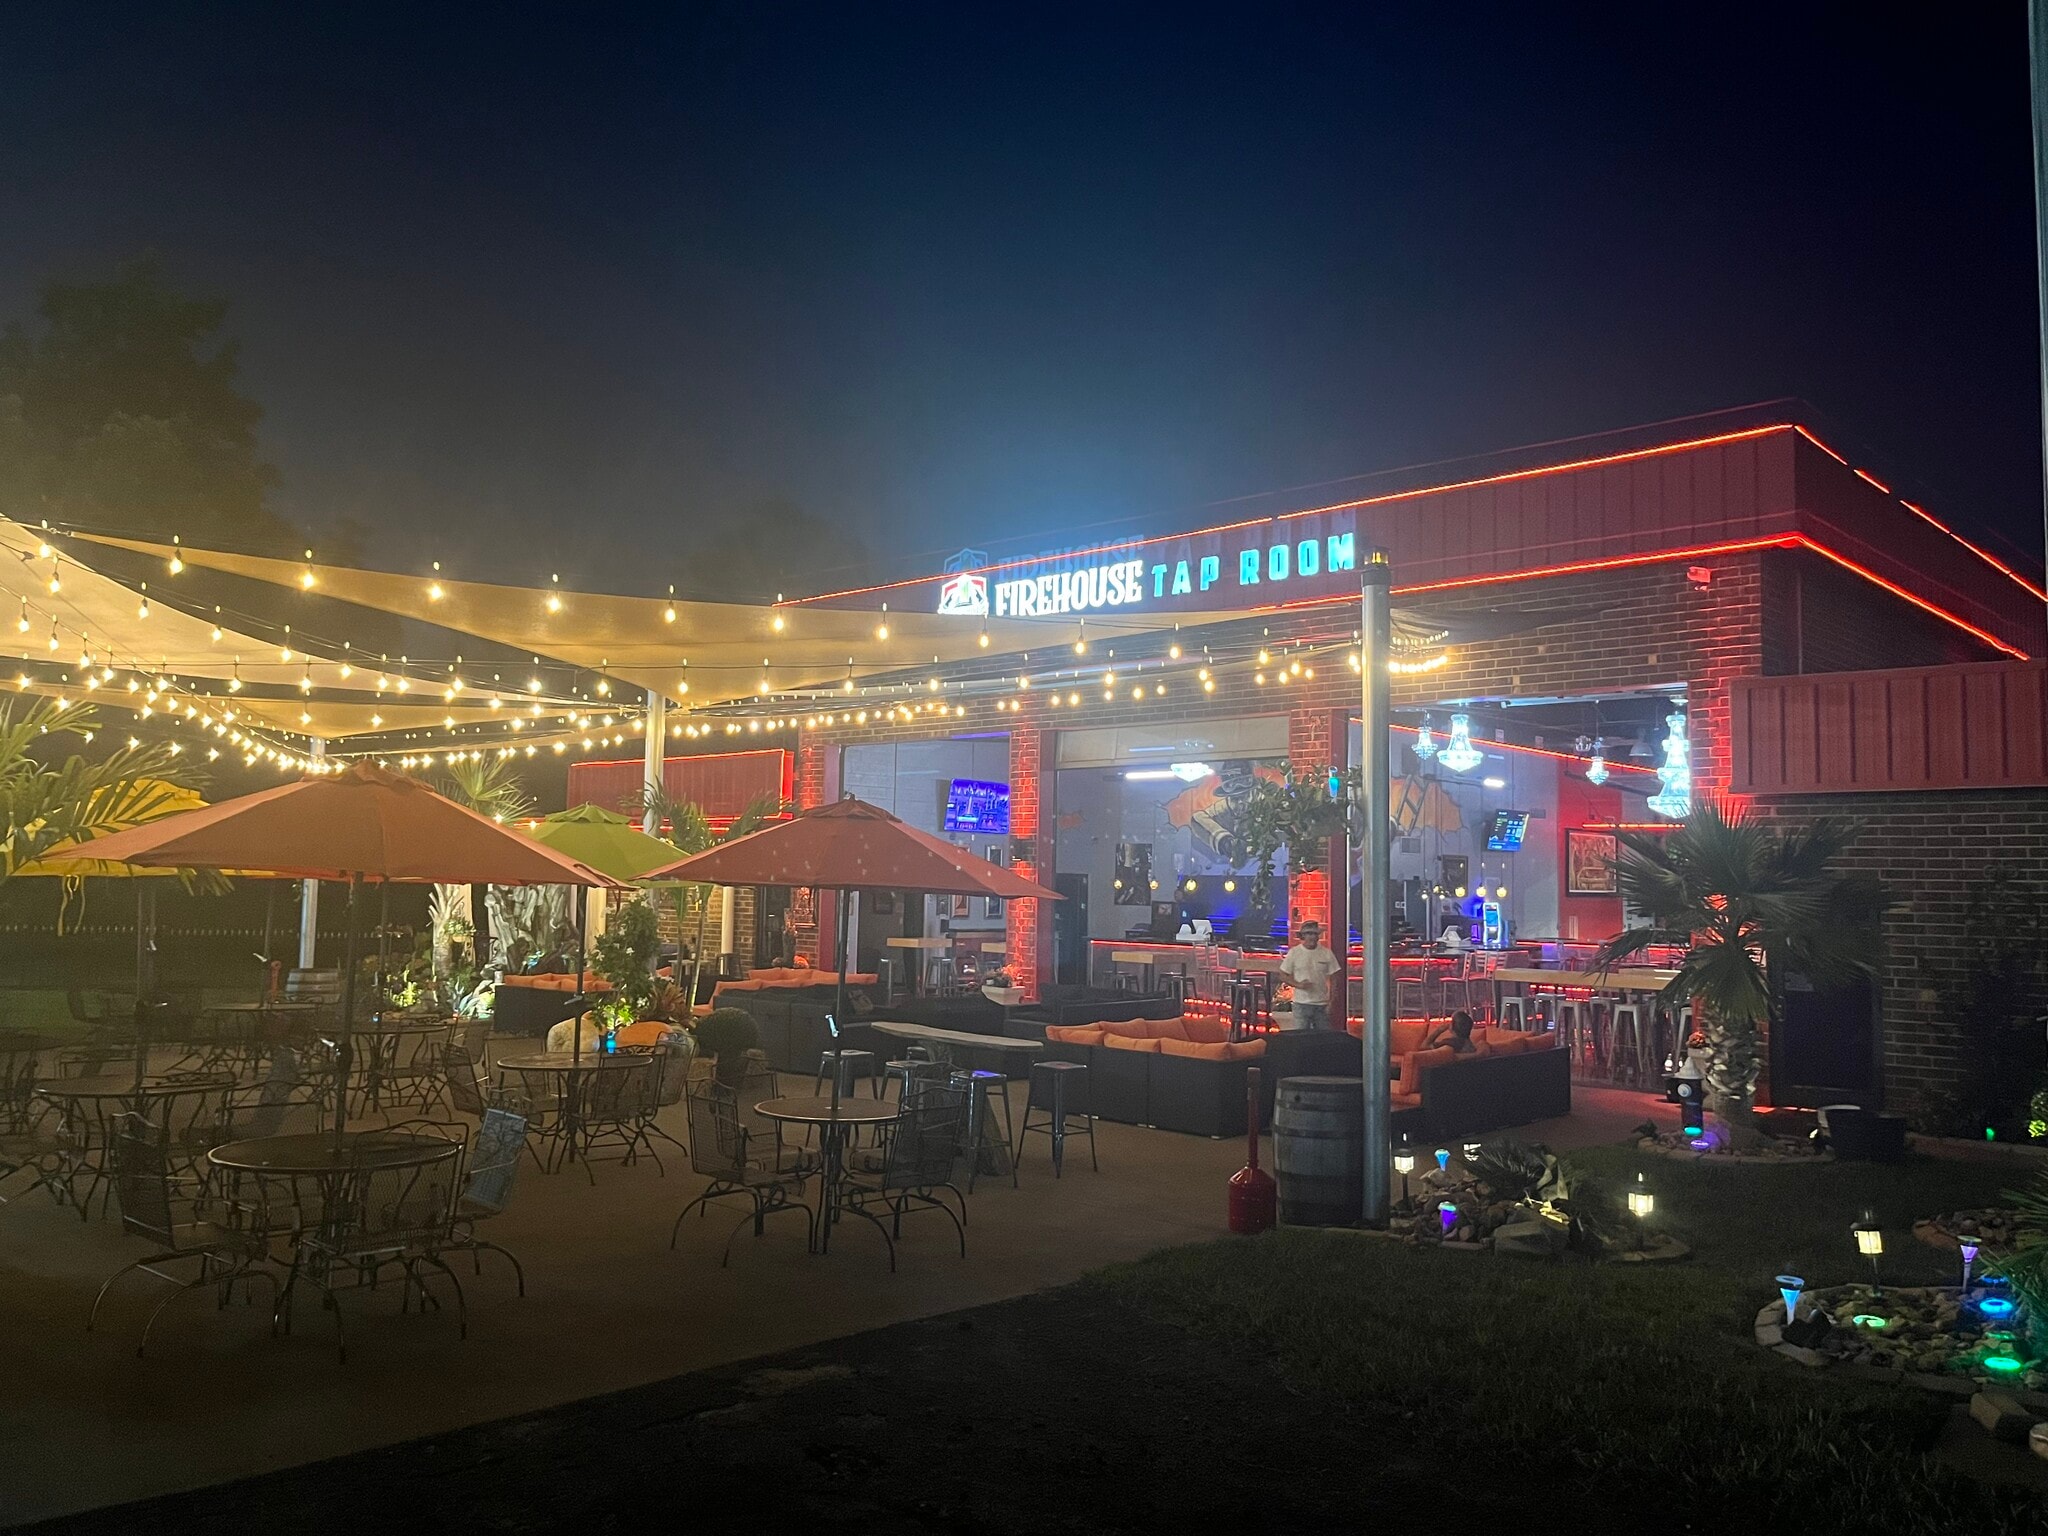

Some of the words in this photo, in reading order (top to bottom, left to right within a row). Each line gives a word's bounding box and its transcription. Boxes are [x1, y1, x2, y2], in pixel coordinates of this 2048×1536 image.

[995, 560, 1143, 616] FIREHOUSE
[1152, 555, 1219, 597] TAP
[1240, 533, 1354, 585] ROOM
